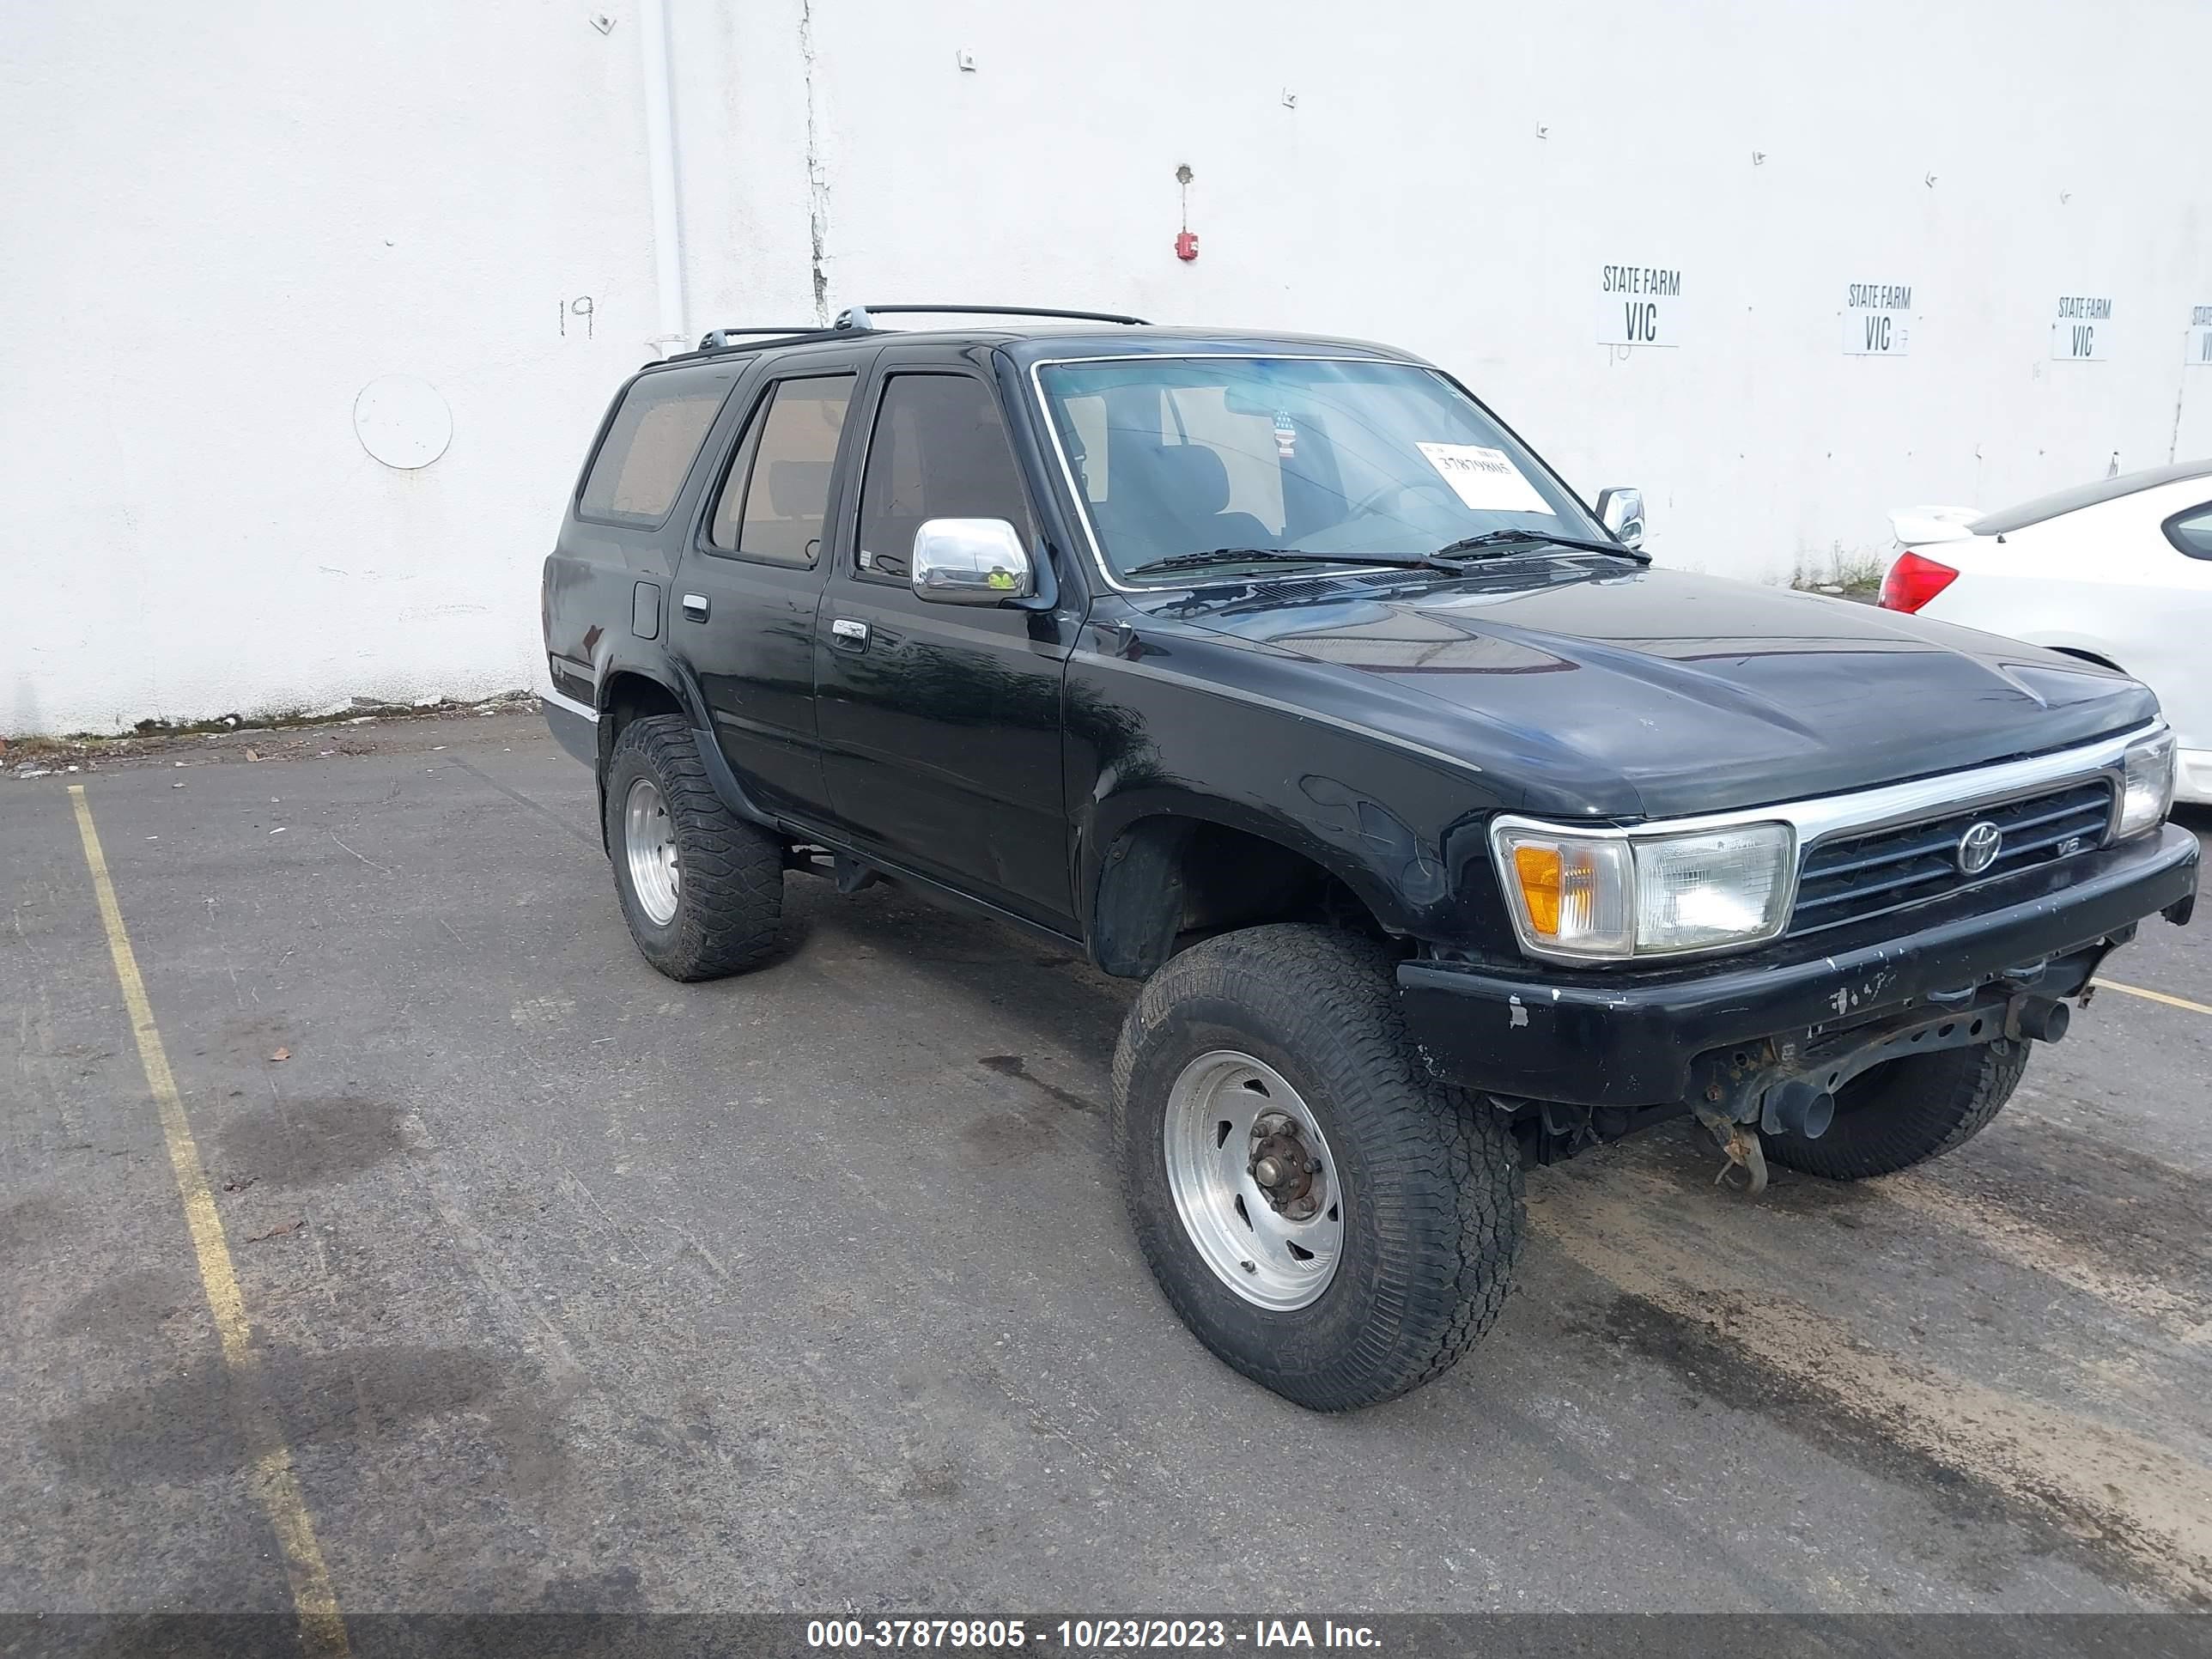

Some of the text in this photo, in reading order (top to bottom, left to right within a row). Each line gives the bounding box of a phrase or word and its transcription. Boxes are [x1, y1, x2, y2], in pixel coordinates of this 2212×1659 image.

[1603, 265, 1680, 295] STATE FARM
[1849, 283, 1911, 309] STATE FARM
[2058, 296, 2112, 319] STATE FARM
[560, 295, 593, 340] 19
[1626, 301, 1656, 342] VIC
[1866, 315, 1891, 350] VIC
[2073, 325, 2094, 356] VIC
[2202, 331, 2212, 362] VI
[1437, 457, 1512, 475] 37879805
[2057, 836, 2080, 856] V6
